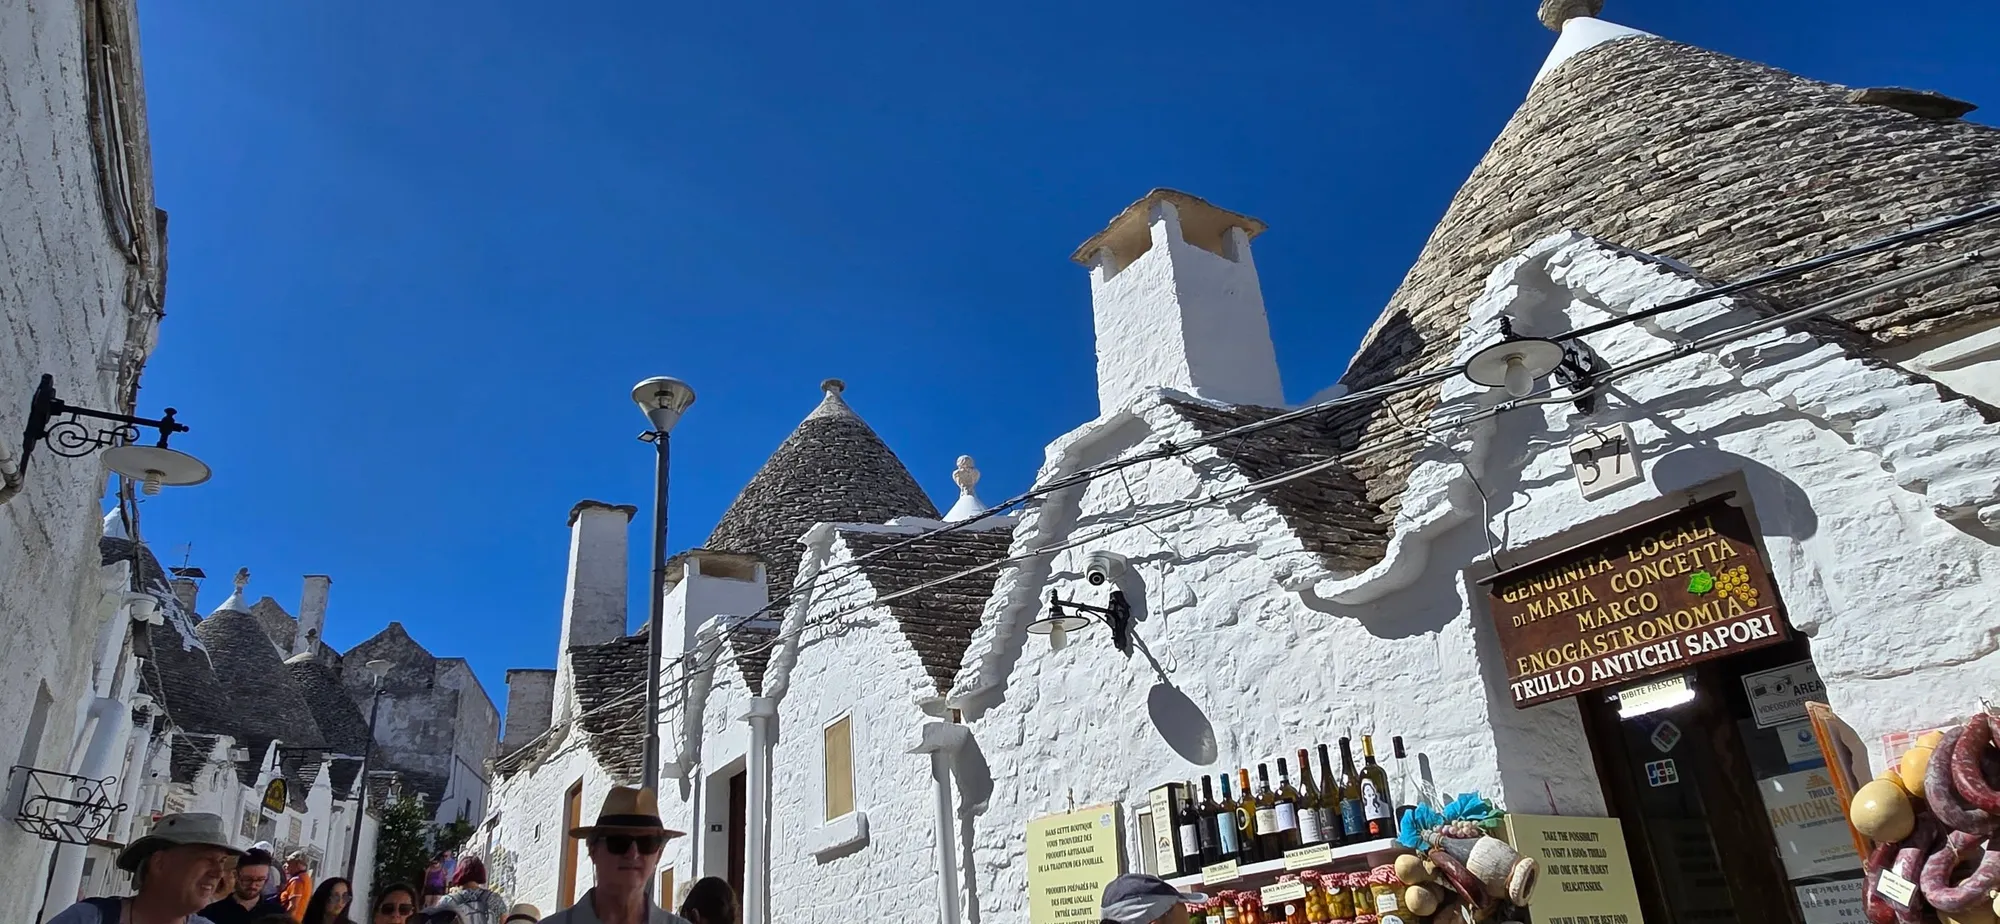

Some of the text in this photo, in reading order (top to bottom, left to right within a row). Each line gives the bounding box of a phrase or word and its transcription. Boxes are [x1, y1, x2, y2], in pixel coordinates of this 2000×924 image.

[1626, 515, 1717, 562] LOCALI
[1512, 538, 1737, 628] DI MARIA CONCETTA
[1576, 592, 1658, 632] MARCO
[1516, 596, 1746, 677] ENOGASTRONOMIA
[1510, 614, 1778, 701] TRULLO ANTICHI SAPORI
[1621, 677, 1683, 700] BIBITE FRESCHE
[1793, 680, 1824, 696] AREA
[1808, 786, 1835, 799] TRULLO
[1771, 799, 1832, 828] ANTICHI
